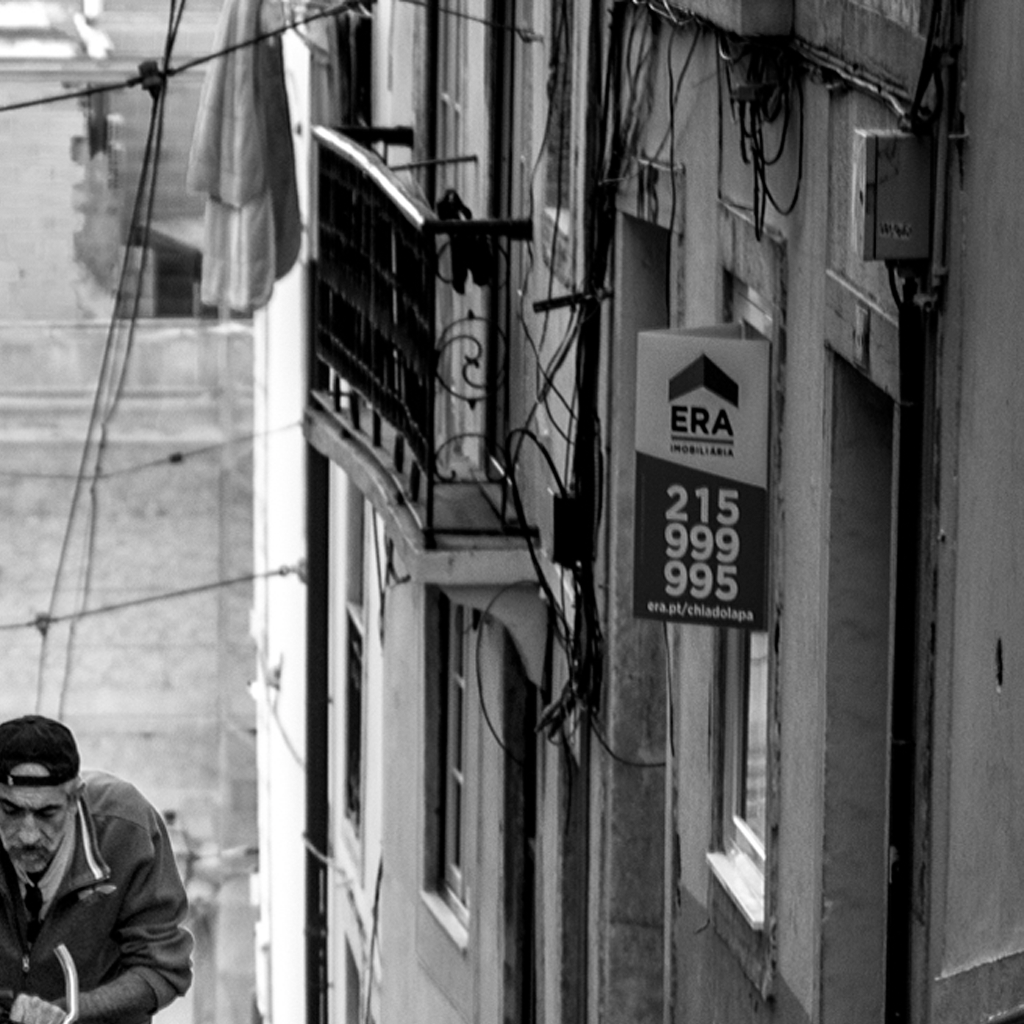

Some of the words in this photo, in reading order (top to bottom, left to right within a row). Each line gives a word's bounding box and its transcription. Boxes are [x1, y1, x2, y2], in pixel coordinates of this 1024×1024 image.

[671, 405, 734, 436] ERA
[665, 484, 740, 526] 215
[664, 522, 740, 563] 999
[663, 560, 739, 601] 995
[647, 601, 754, 622] era.pt/chiadolapa
